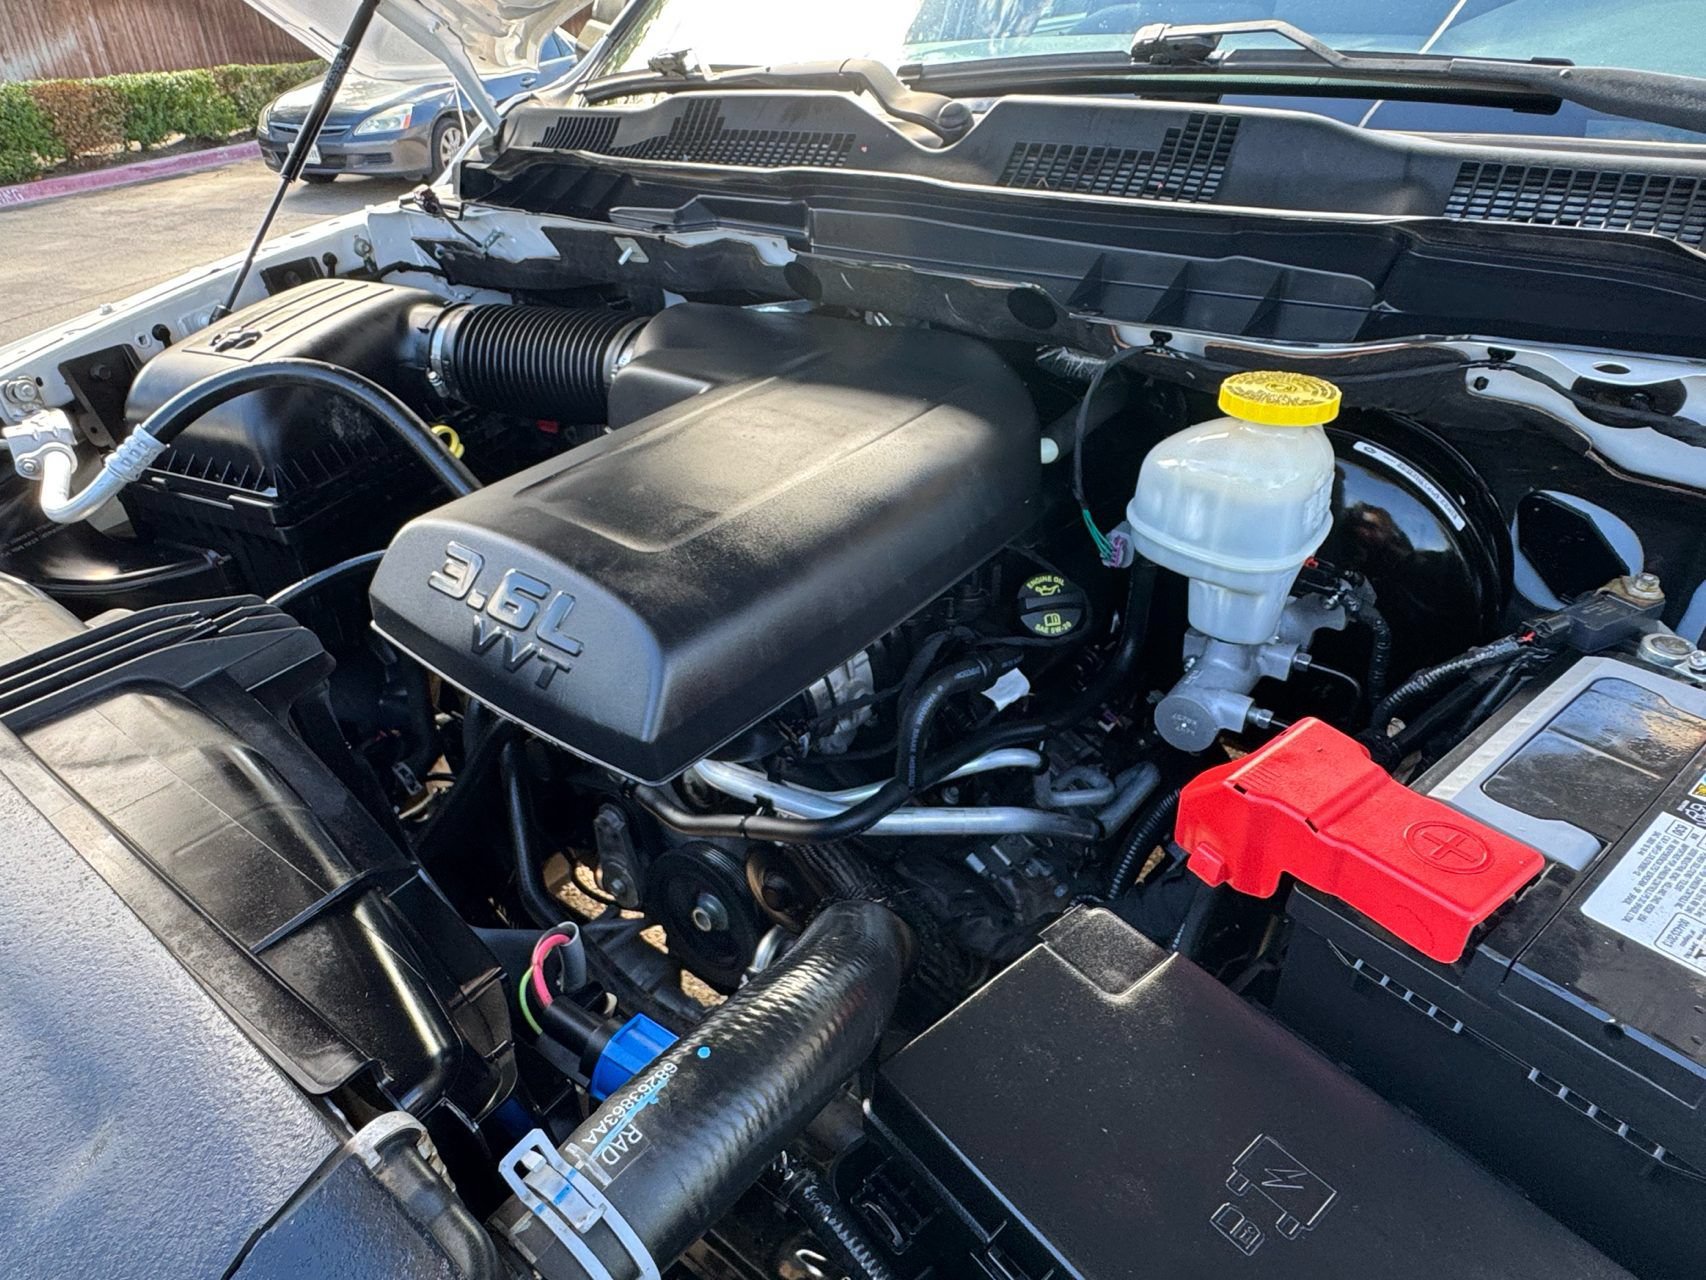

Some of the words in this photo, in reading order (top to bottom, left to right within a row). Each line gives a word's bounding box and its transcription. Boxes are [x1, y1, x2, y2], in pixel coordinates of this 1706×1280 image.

[428, 540, 585, 657] 3.6L
[1026, 575, 1052, 589] ENGINE
[1053, 576, 1065, 586] OIL
[471, 614, 573, 690] VVT
[582, 1061, 678, 1145] 68263863AA
[601, 1124, 643, 1165] RAD
